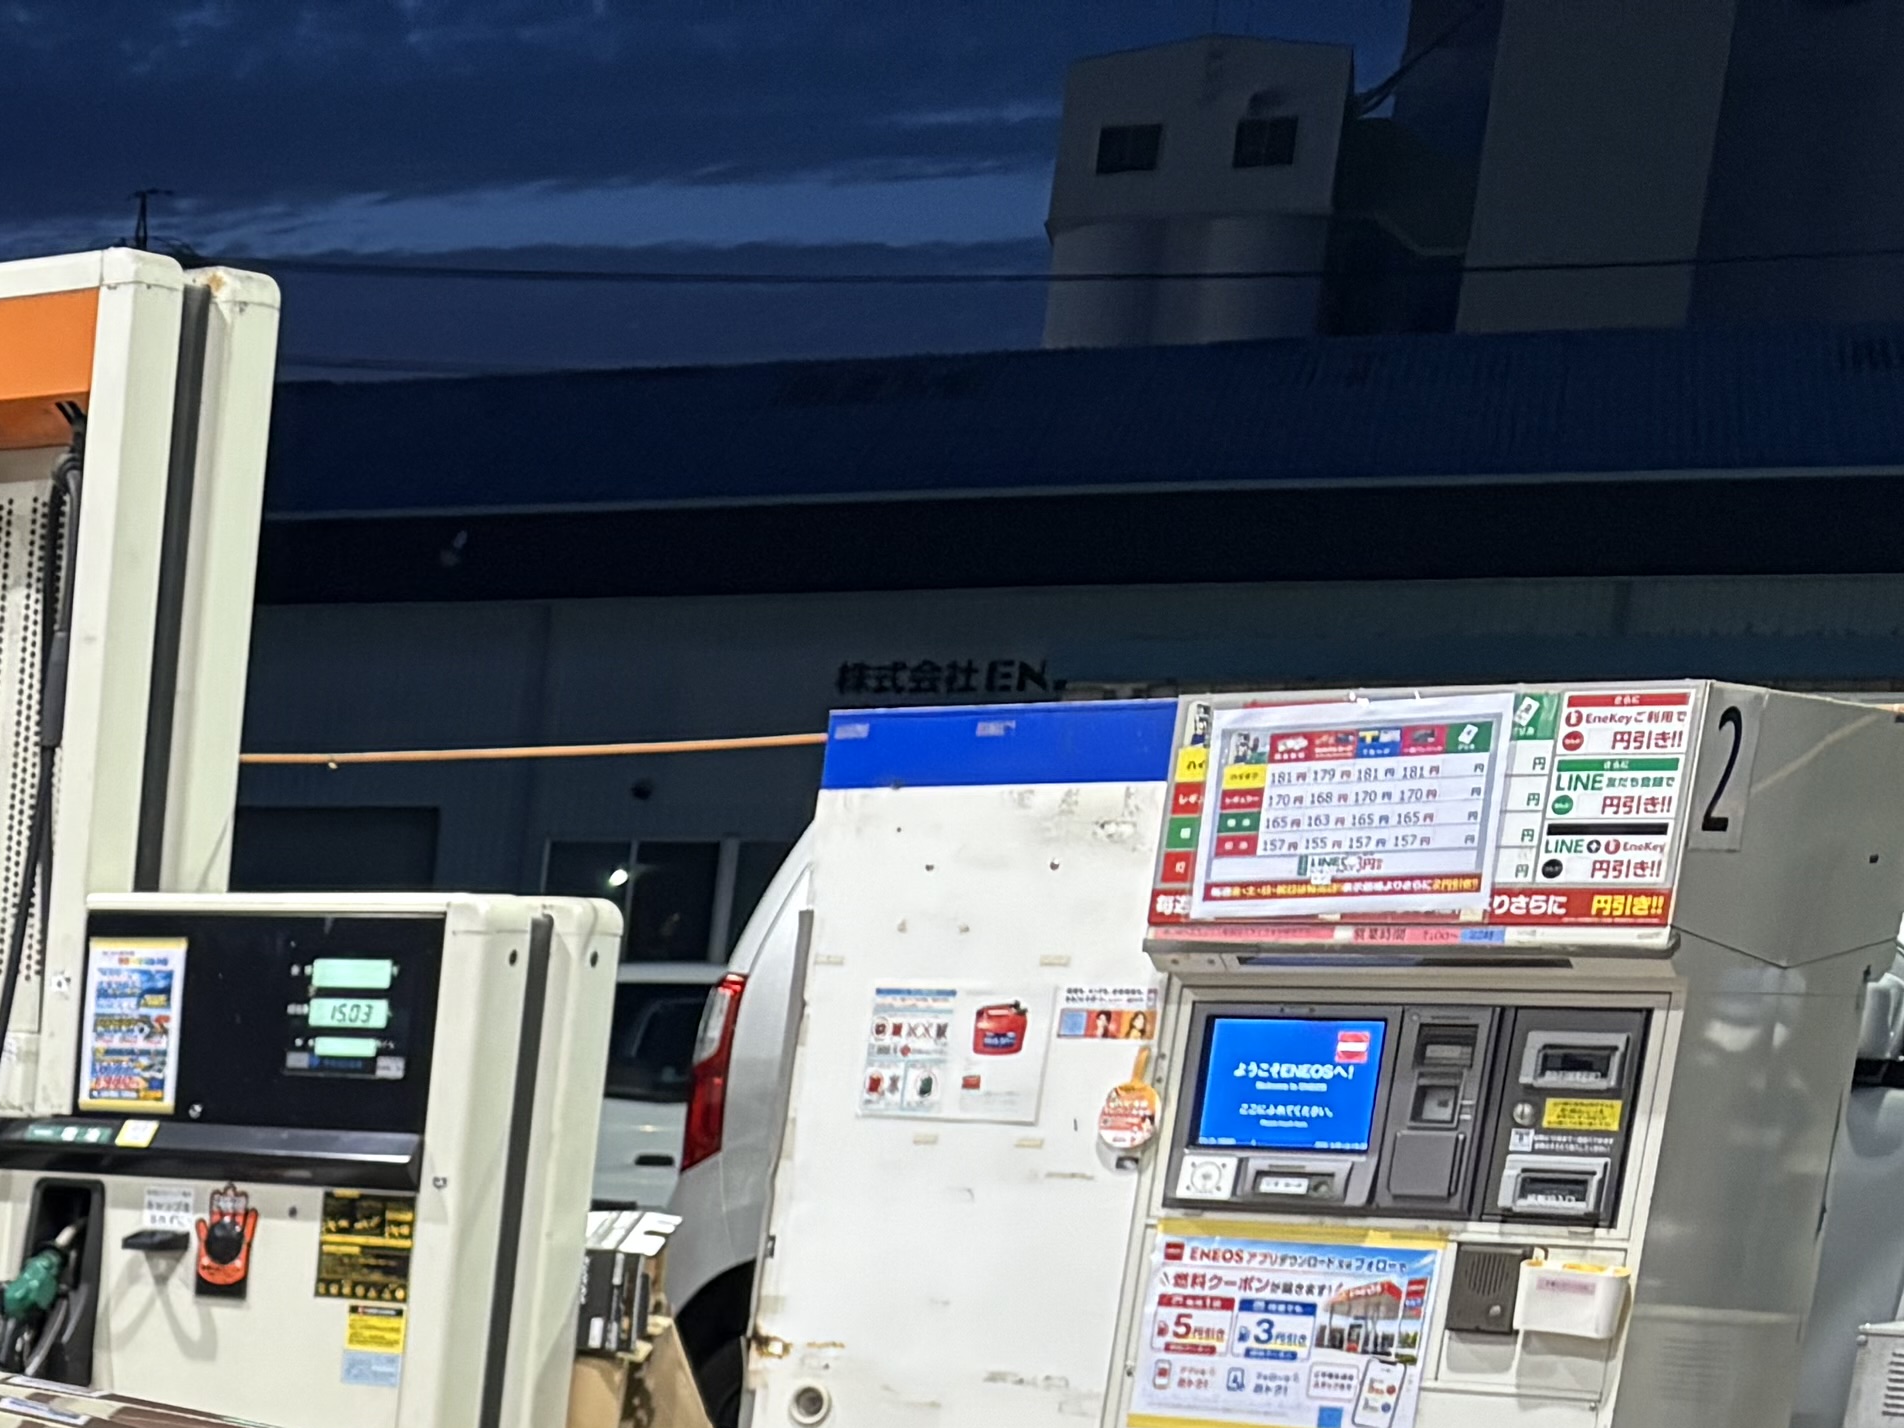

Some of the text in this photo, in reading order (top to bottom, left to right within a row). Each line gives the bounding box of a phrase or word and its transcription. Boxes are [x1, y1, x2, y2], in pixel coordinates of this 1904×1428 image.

[835, 658, 1067, 694] 株式会社EN
[1532, 757, 1546, 771] 円
[1701, 705, 1743, 832] 2
[1271, 771, 1293, 784] 181
[1313, 769, 1335, 781] 179
[1357, 768, 1379, 780] 181
[1402, 765, 1424, 778] 181
[1268, 794, 1290, 807] 170
[1311, 792, 1333, 804] 168
[1355, 790, 1377, 803] 170
[1400, 789, 1423, 801] 170
[1527, 793, 1540, 806] 円
[1265, 816, 1288, 828] 165
[1307, 814, 1330, 827] 163
[1351, 812, 1374, 825] 165
[1396, 811, 1420, 824] 165
[1262, 839, 1285, 852] 157
[1304, 837, 1327, 850] 155
[1348, 835, 1372, 848] 157
[1394, 834, 1417, 846] 157
[1521, 829, 1534, 842] 円
[1544, 839, 1585, 854] LINE
[1515, 864, 1529, 878] 円
